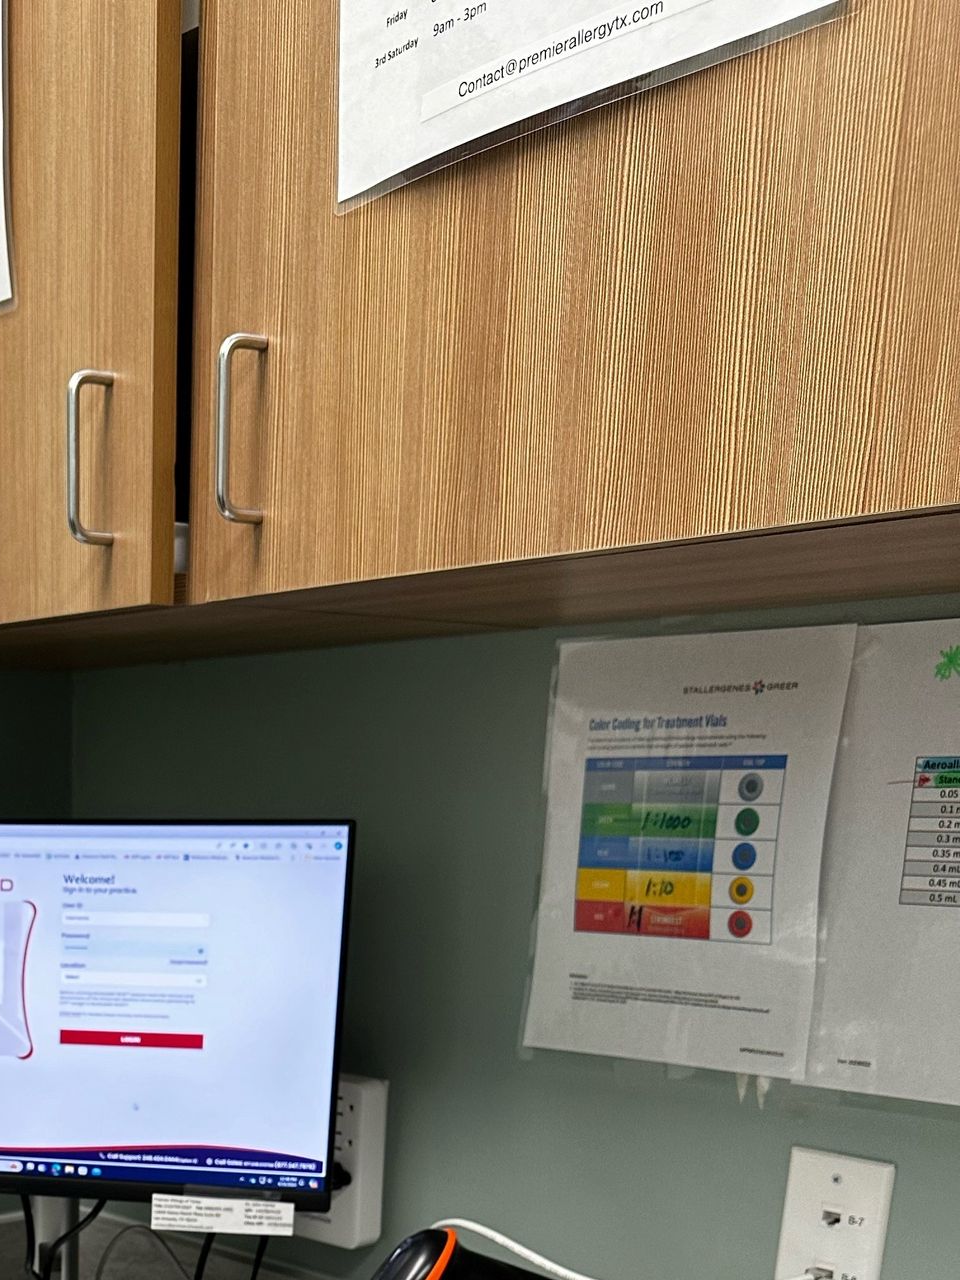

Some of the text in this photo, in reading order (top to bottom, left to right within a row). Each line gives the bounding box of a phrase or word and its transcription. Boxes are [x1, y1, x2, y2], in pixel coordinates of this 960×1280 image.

[386, 9, 408, 28] Friday
[433, 18, 454, 36] 9am
[464, 2, 486, 22] 3pm
[374, 38, 418, 68] 3rd Saturday
[458, 1, 664, 98] Contact@premierallergytx.com
[683, 681, 798, 694] STALLERGENES GREER
[590, 714, 728, 732] Color Coding for Treatment Vials
[924, 760, 960, 770] Aeroall
[939, 775, 960, 784] Stan
[940, 790, 958, 798] 0.05
[940, 805, 954, 814] 0.1
[938, 820, 952, 828] 0.2
[936, 835, 950, 843] 0.3
[932, 850, 950, 858] 0.35
[933, 864, 946, 872] 0.4
[63, 874, 116, 885] Welcome!
[928, 879, 947, 888] 0.45
[645, 878, 674, 896] 1:10
[929, 894, 957, 903] 0.5 mL
